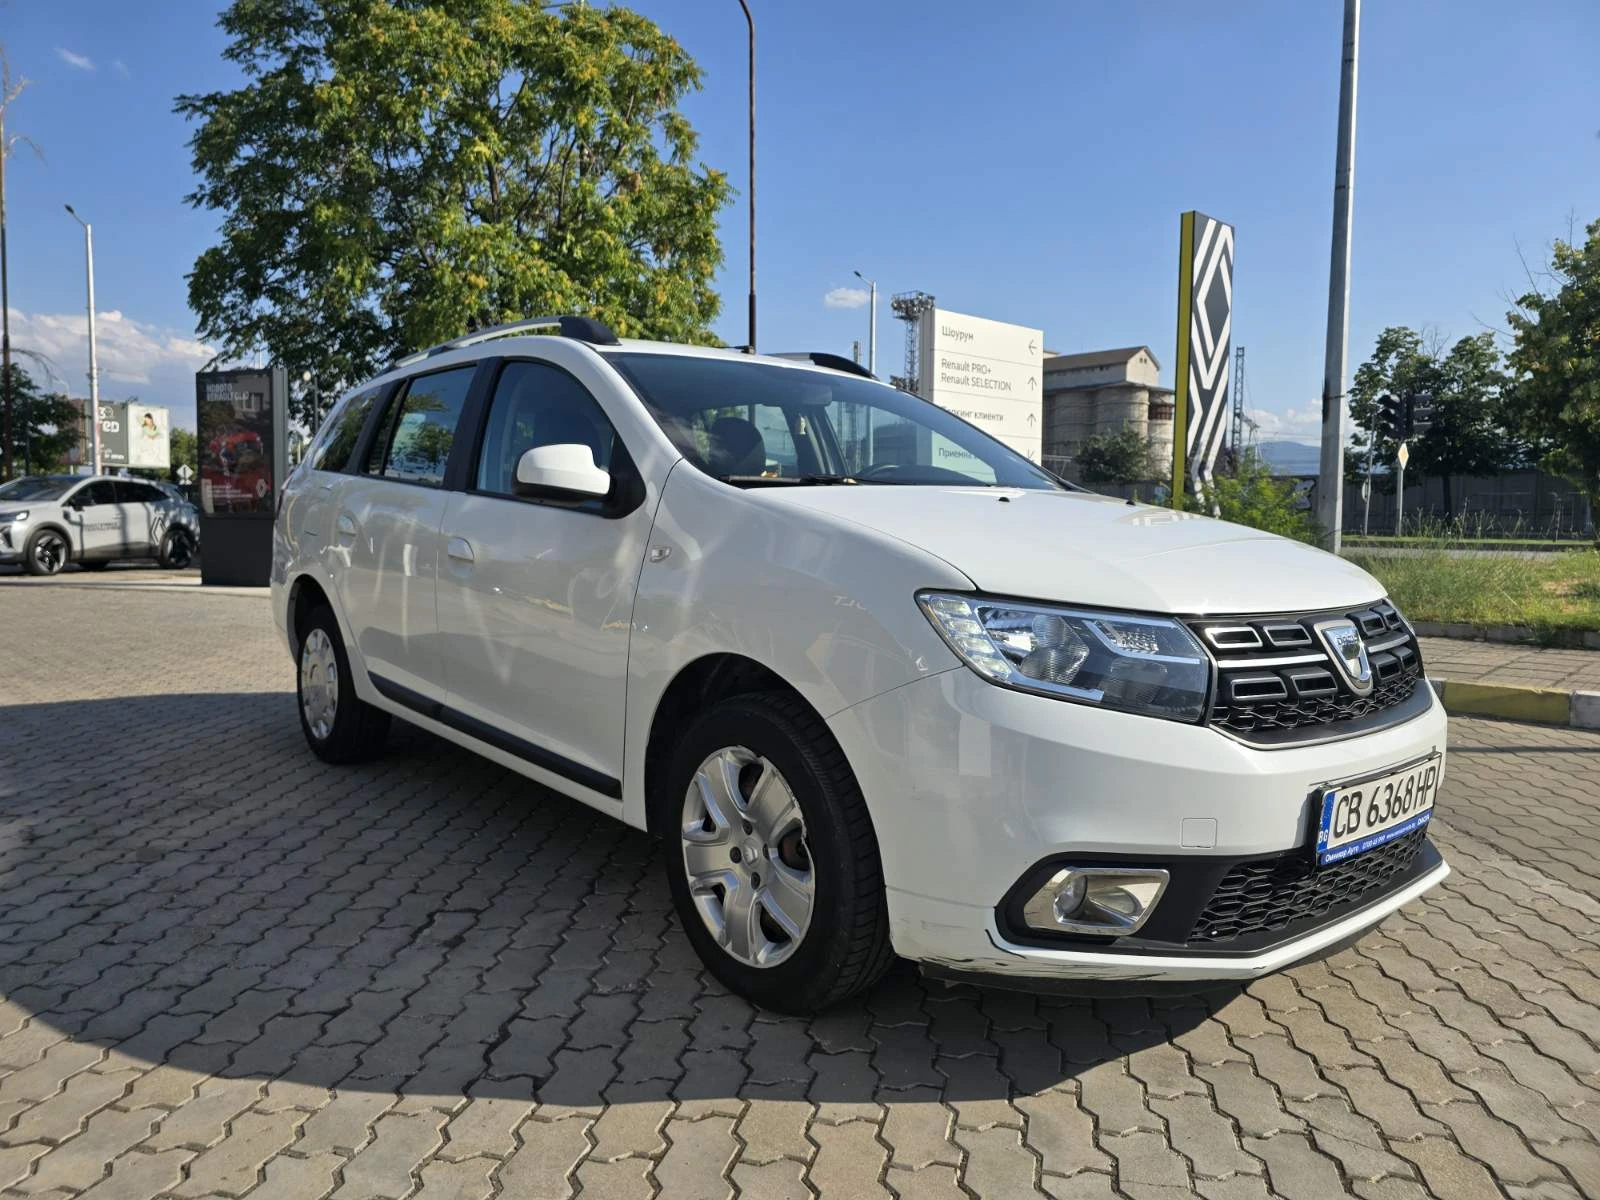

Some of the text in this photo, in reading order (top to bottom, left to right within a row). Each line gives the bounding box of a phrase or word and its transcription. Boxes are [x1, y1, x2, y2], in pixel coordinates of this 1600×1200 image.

[941, 358, 992, 375] Renault PRO+
[941, 372, 1012, 391] Renault SELECTION
[1333, 791, 1363, 838] CB
[1367, 775, 1415, 828] 6368
[1318, 829, 1329, 844] BG
